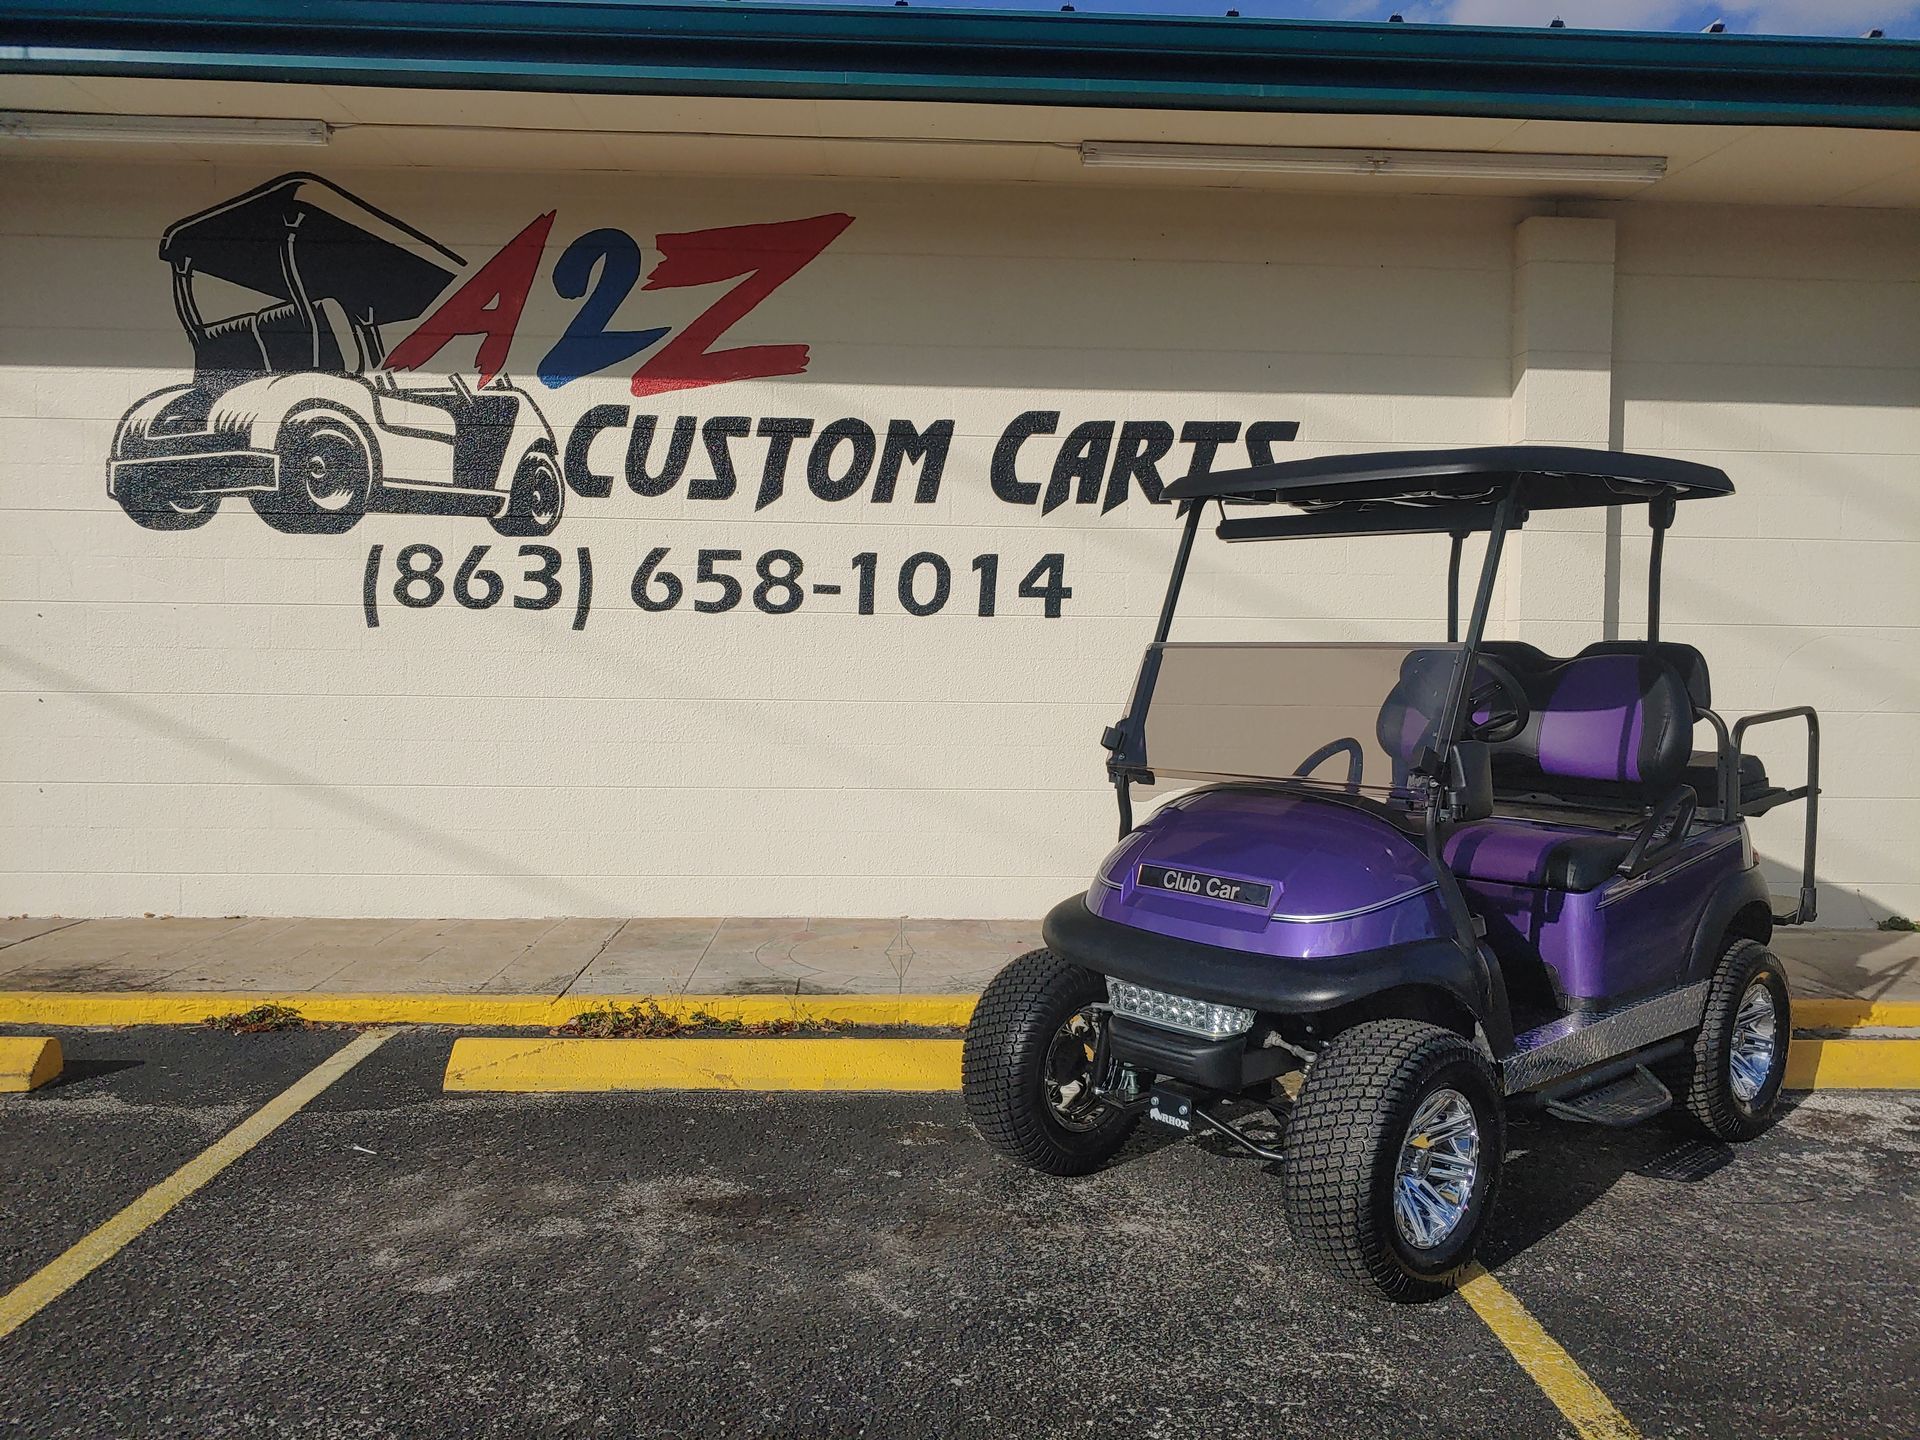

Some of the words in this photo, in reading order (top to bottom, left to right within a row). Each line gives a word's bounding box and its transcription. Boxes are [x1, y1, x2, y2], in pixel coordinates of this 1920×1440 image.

[380, 209, 857, 396] A2Z
[563, 404, 955, 512] CUSTOM
[364, 544, 592, 629] (863)
[631, 547, 1072, 618] 658-1014
[1163, 870, 1200, 893] Club
[1206, 878, 1240, 900] Car
[1160, 1112, 1189, 1131] RHOX
